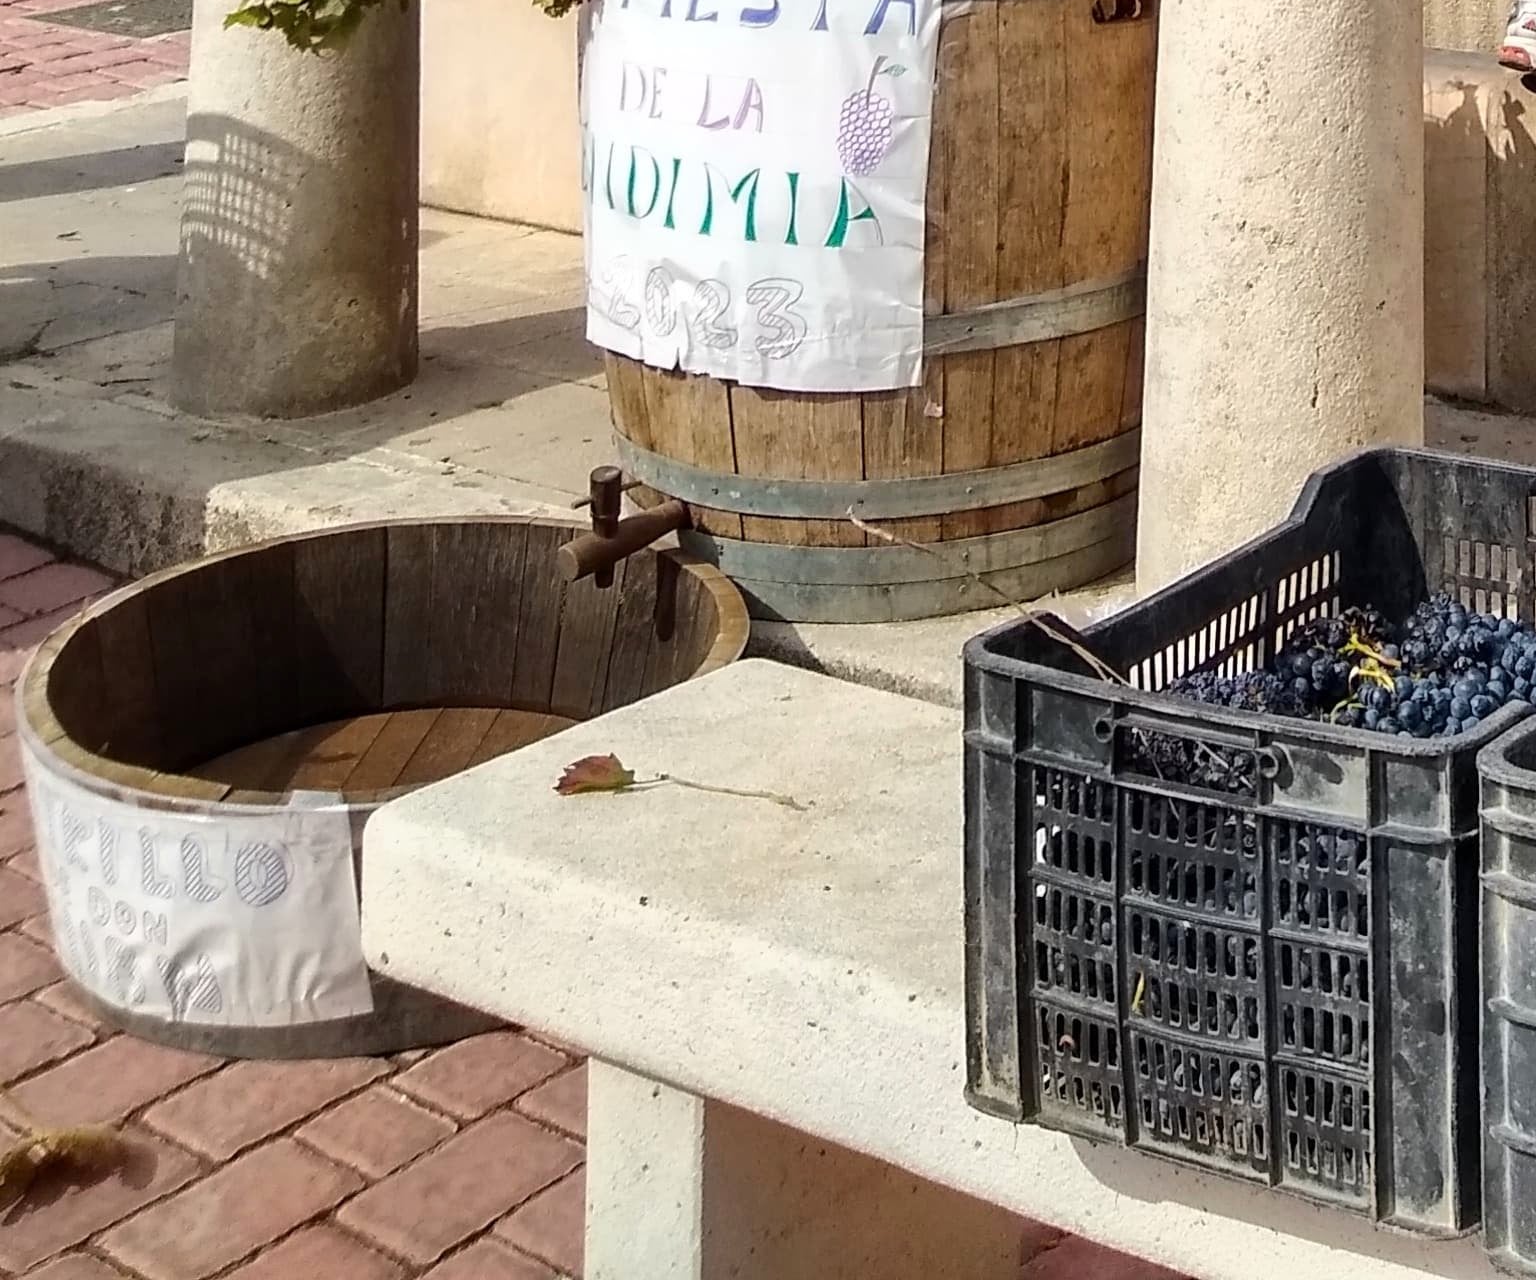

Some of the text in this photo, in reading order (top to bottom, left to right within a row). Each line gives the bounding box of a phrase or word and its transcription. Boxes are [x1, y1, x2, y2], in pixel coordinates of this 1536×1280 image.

[619, 61, 765, 134] DE LA
[603, 254, 808, 361] 2023
